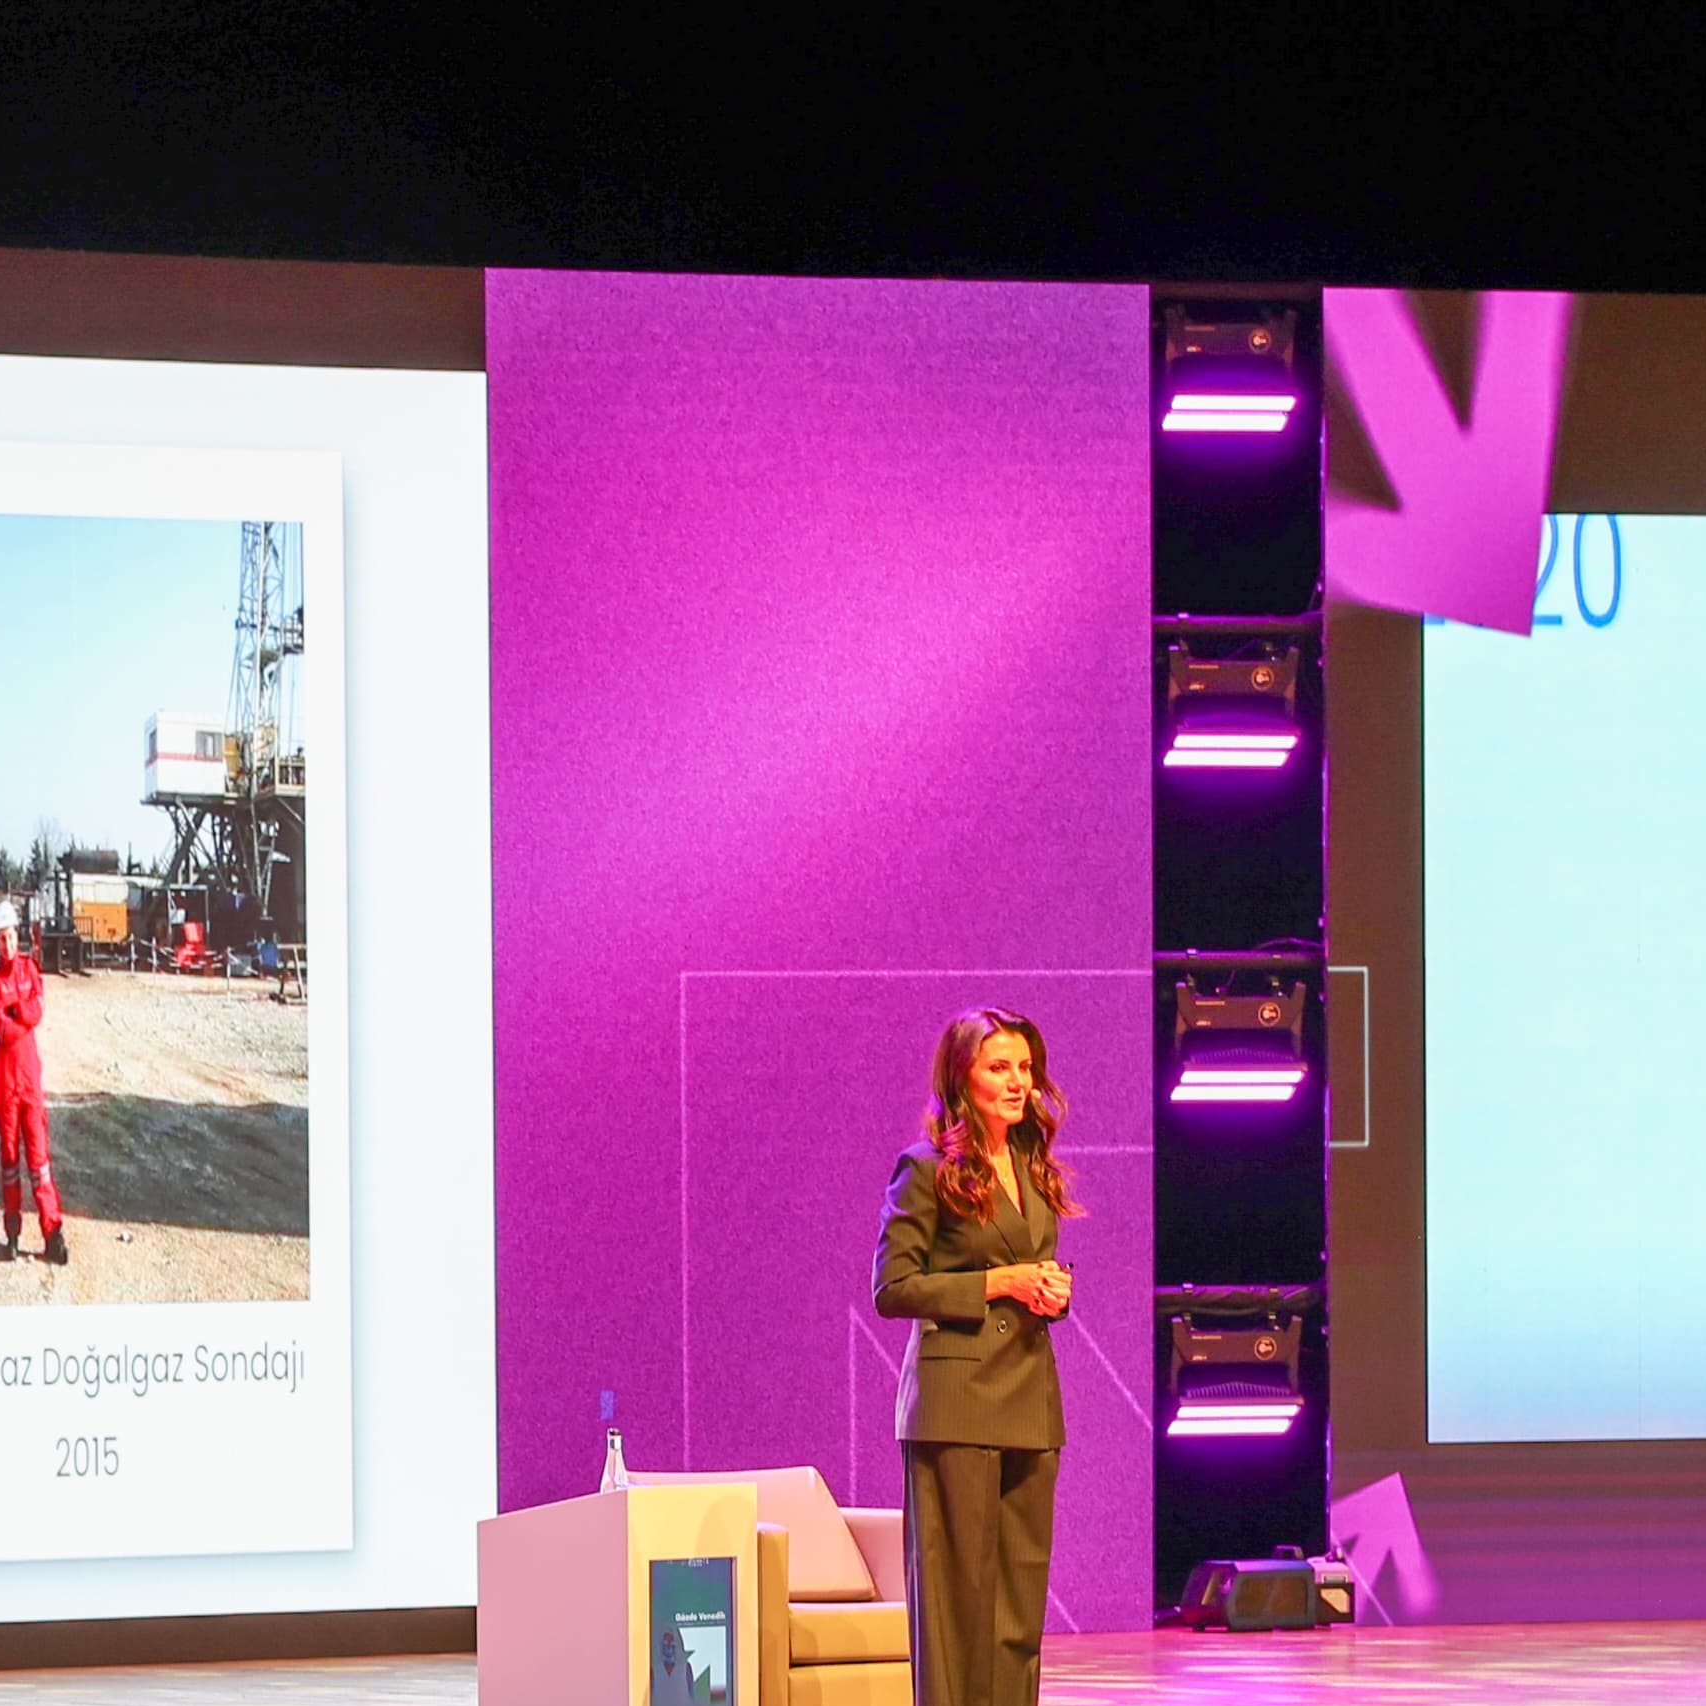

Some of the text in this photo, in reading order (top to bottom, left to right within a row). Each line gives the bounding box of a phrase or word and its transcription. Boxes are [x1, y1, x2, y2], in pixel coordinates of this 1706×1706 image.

[42, 1344, 184, 1398] Doğalgaz
[193, 1339, 306, 1394] Sondajı
[55, 1437, 120, 1478] 2015
